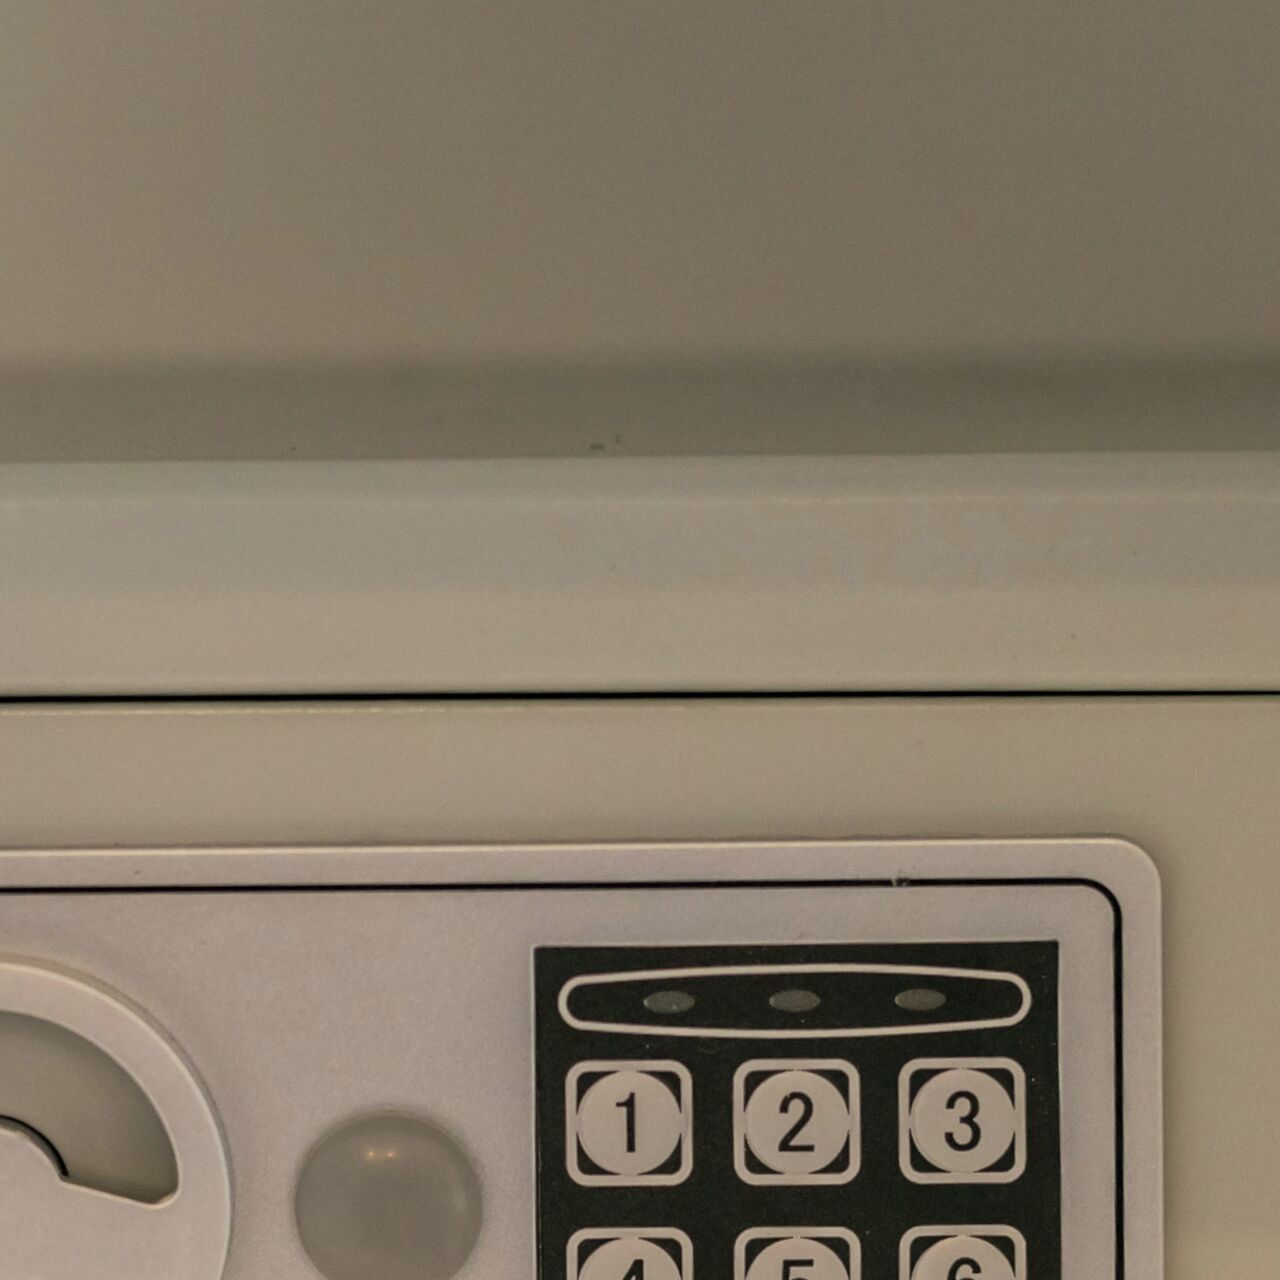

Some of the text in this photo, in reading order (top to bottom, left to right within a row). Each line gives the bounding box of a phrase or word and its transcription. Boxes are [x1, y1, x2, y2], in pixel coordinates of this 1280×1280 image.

[615, 1089, 982, 1154] 1 2 3
